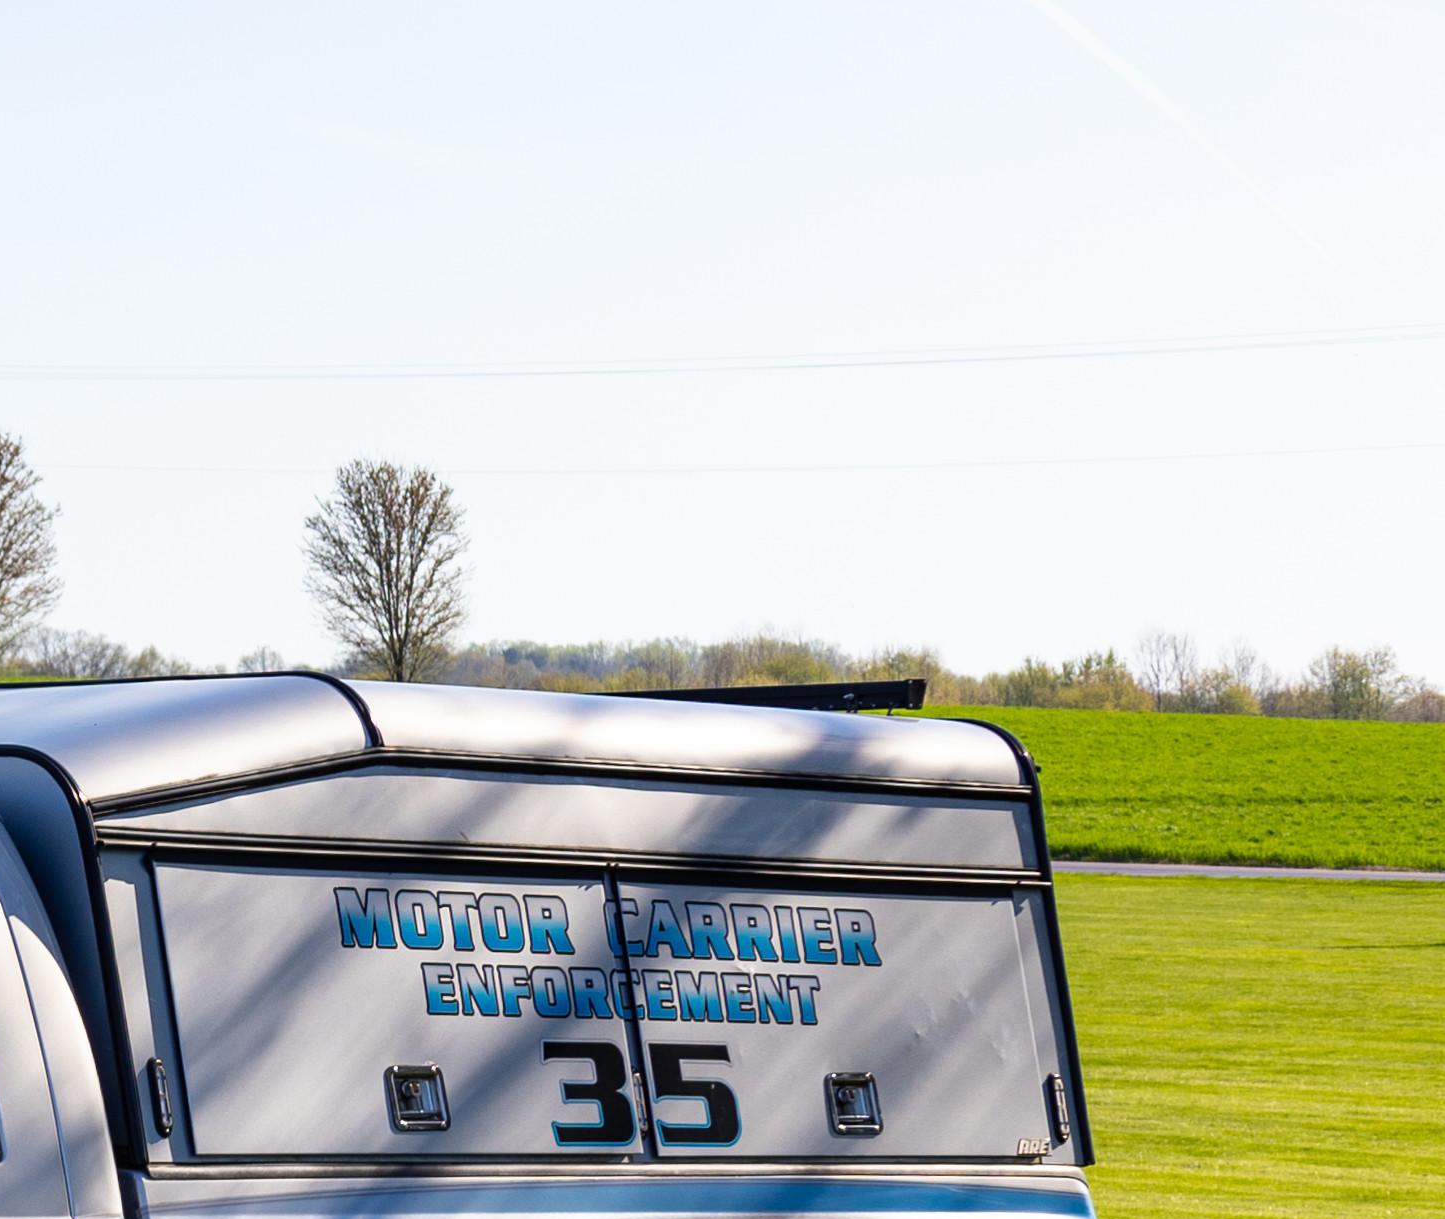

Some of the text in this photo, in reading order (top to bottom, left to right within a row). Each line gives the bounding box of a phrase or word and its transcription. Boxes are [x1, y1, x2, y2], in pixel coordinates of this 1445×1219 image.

[334, 887, 882, 967] MOTOR CARRIER
[421, 962, 821, 1024] ENFORCEMENT
[541, 1039, 741, 1147] 35
